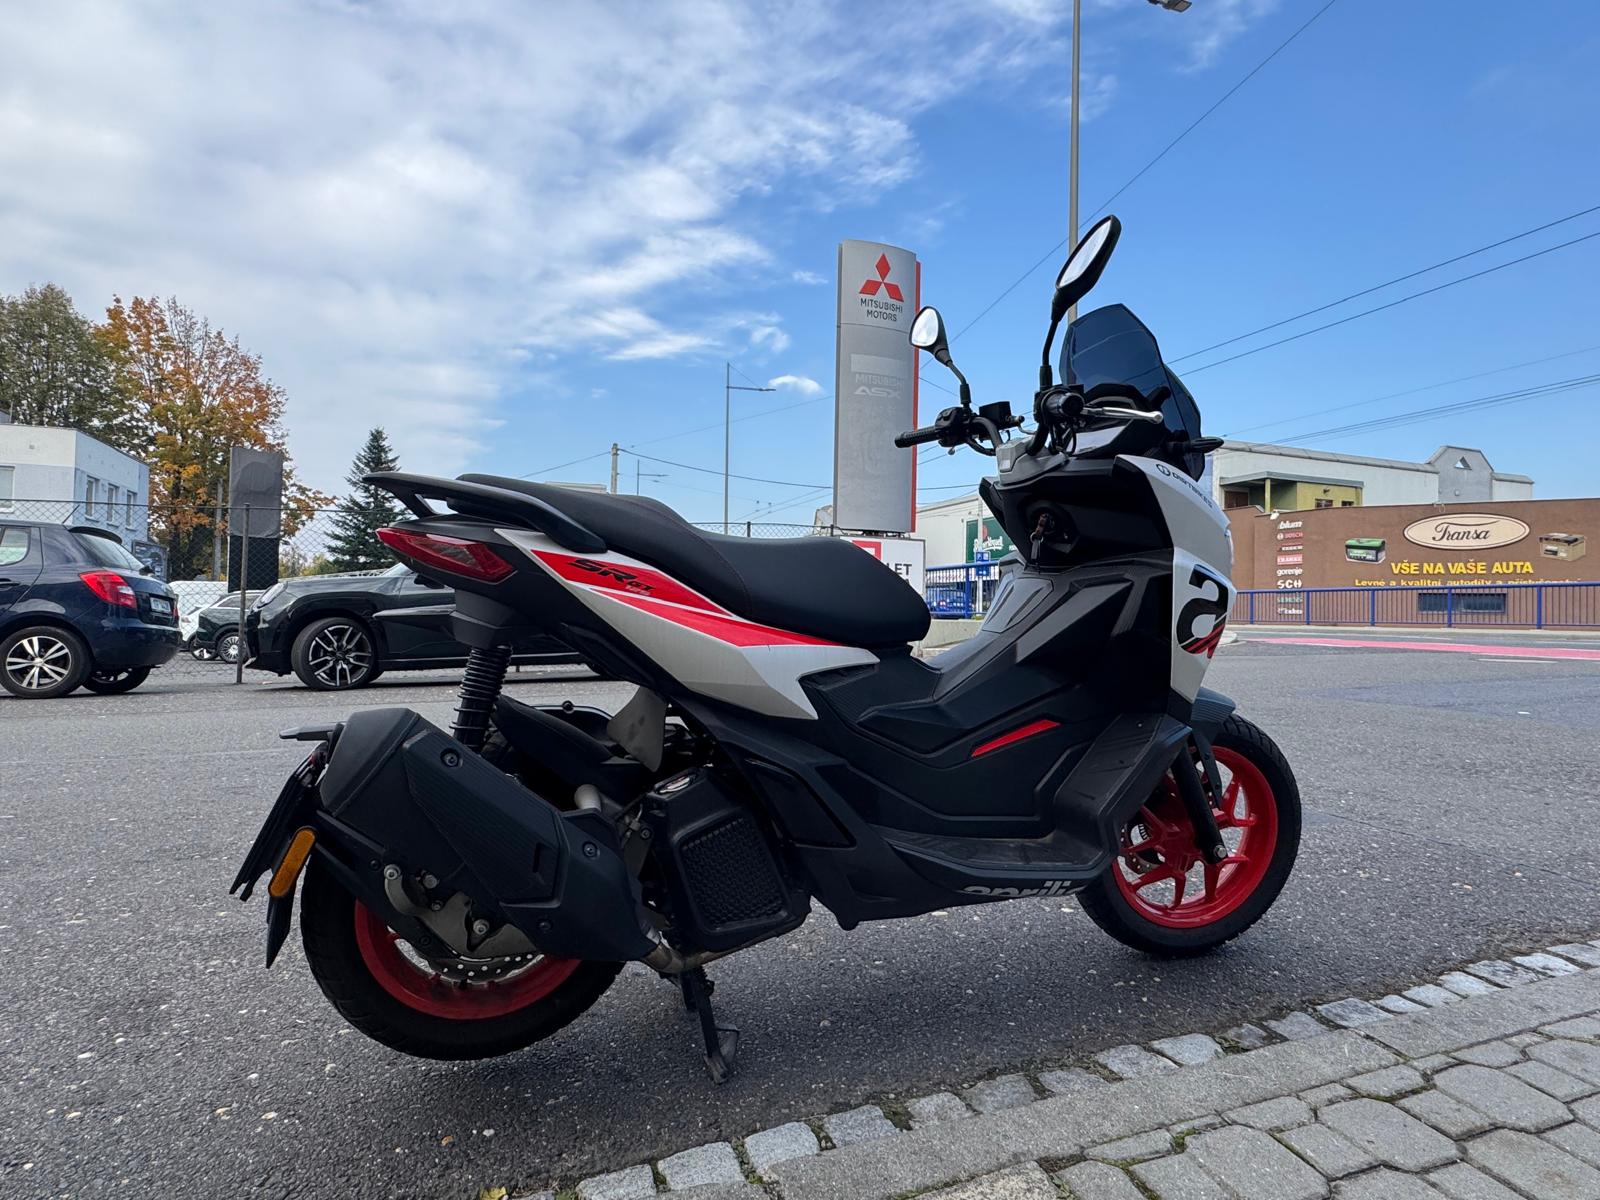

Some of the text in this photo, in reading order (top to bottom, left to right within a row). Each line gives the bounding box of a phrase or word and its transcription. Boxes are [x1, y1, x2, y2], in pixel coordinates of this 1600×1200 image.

[860, 297, 903, 314] MITSUBISHI
[866, 312, 898, 322] MOTORS
[1432, 519, 1500, 542] Transa
[886, 562, 912, 576] ET
[1391, 558, 1534, 575] VŠE NA VAŠE AUTA
[1276, 579, 1303, 589] SCH
[1355, 578, 1386, 587] Levné
